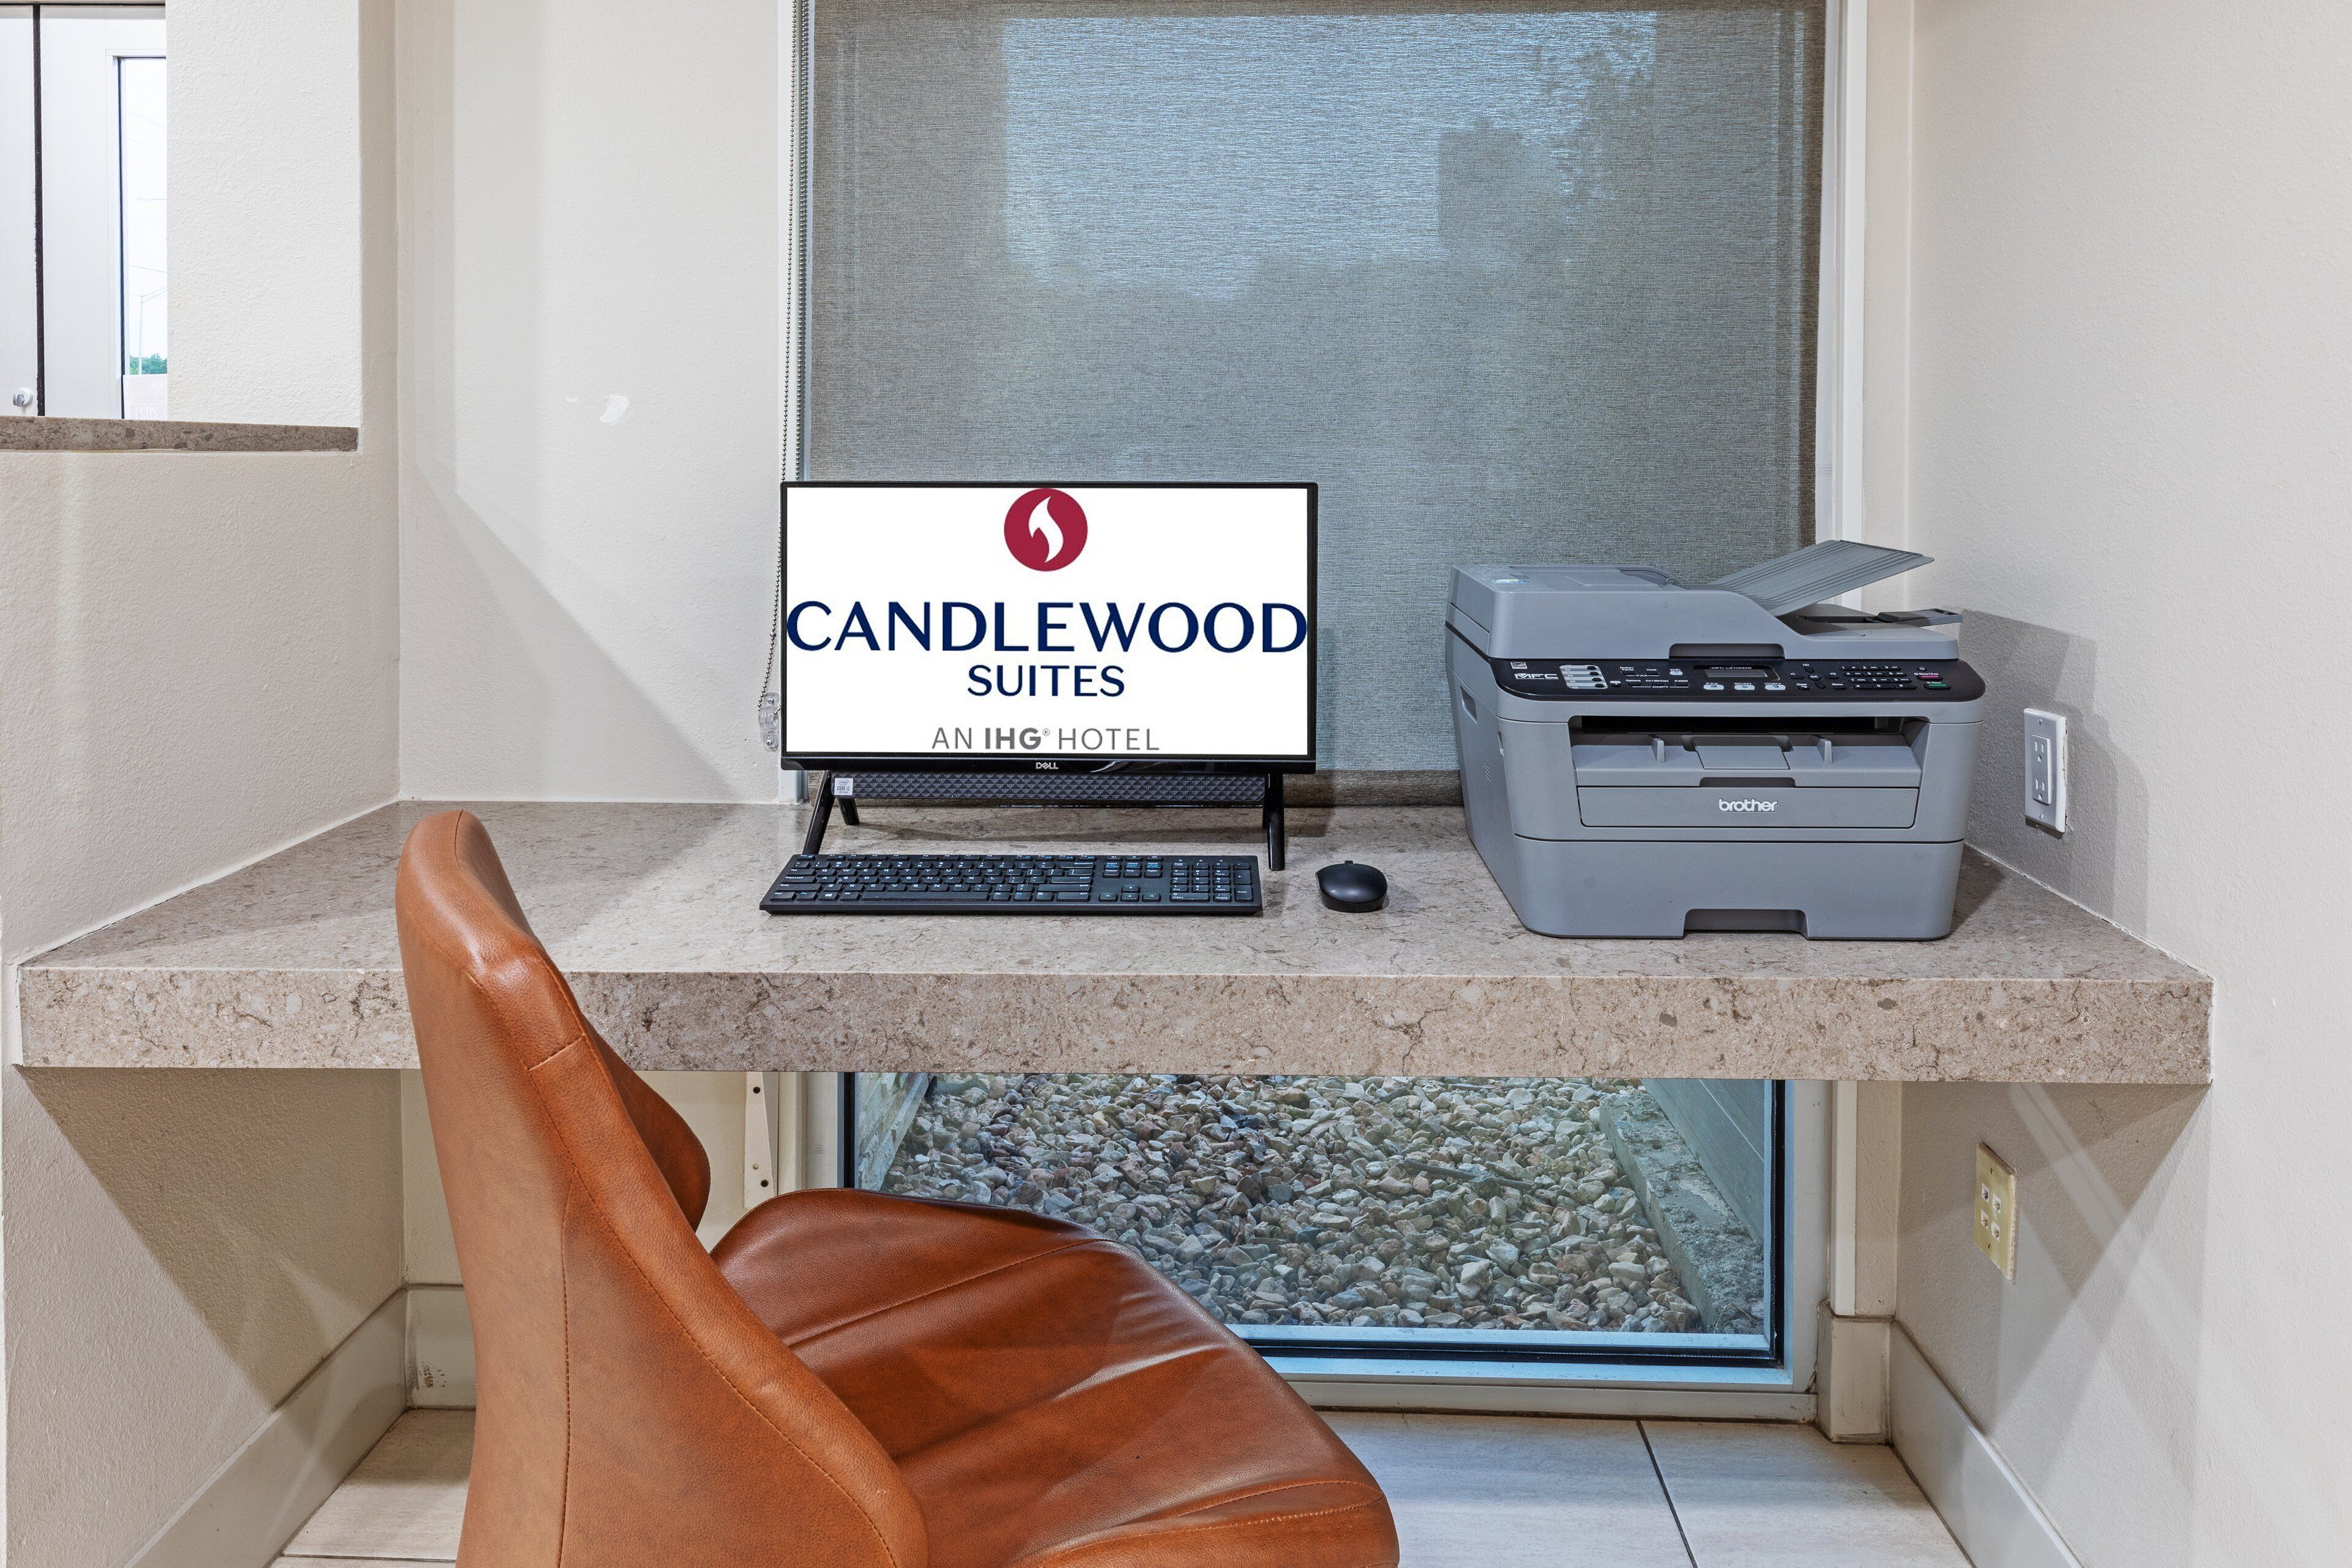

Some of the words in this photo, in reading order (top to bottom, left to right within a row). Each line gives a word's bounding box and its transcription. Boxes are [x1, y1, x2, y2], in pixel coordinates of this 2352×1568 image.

[787, 600, 1306, 654] CANDLEWOOD
[967, 664, 1125, 697] SUITES
[932, 728, 972, 750] AN
[1059, 728, 1159, 750] HOTEL
[1719, 799, 1777, 812] brother
